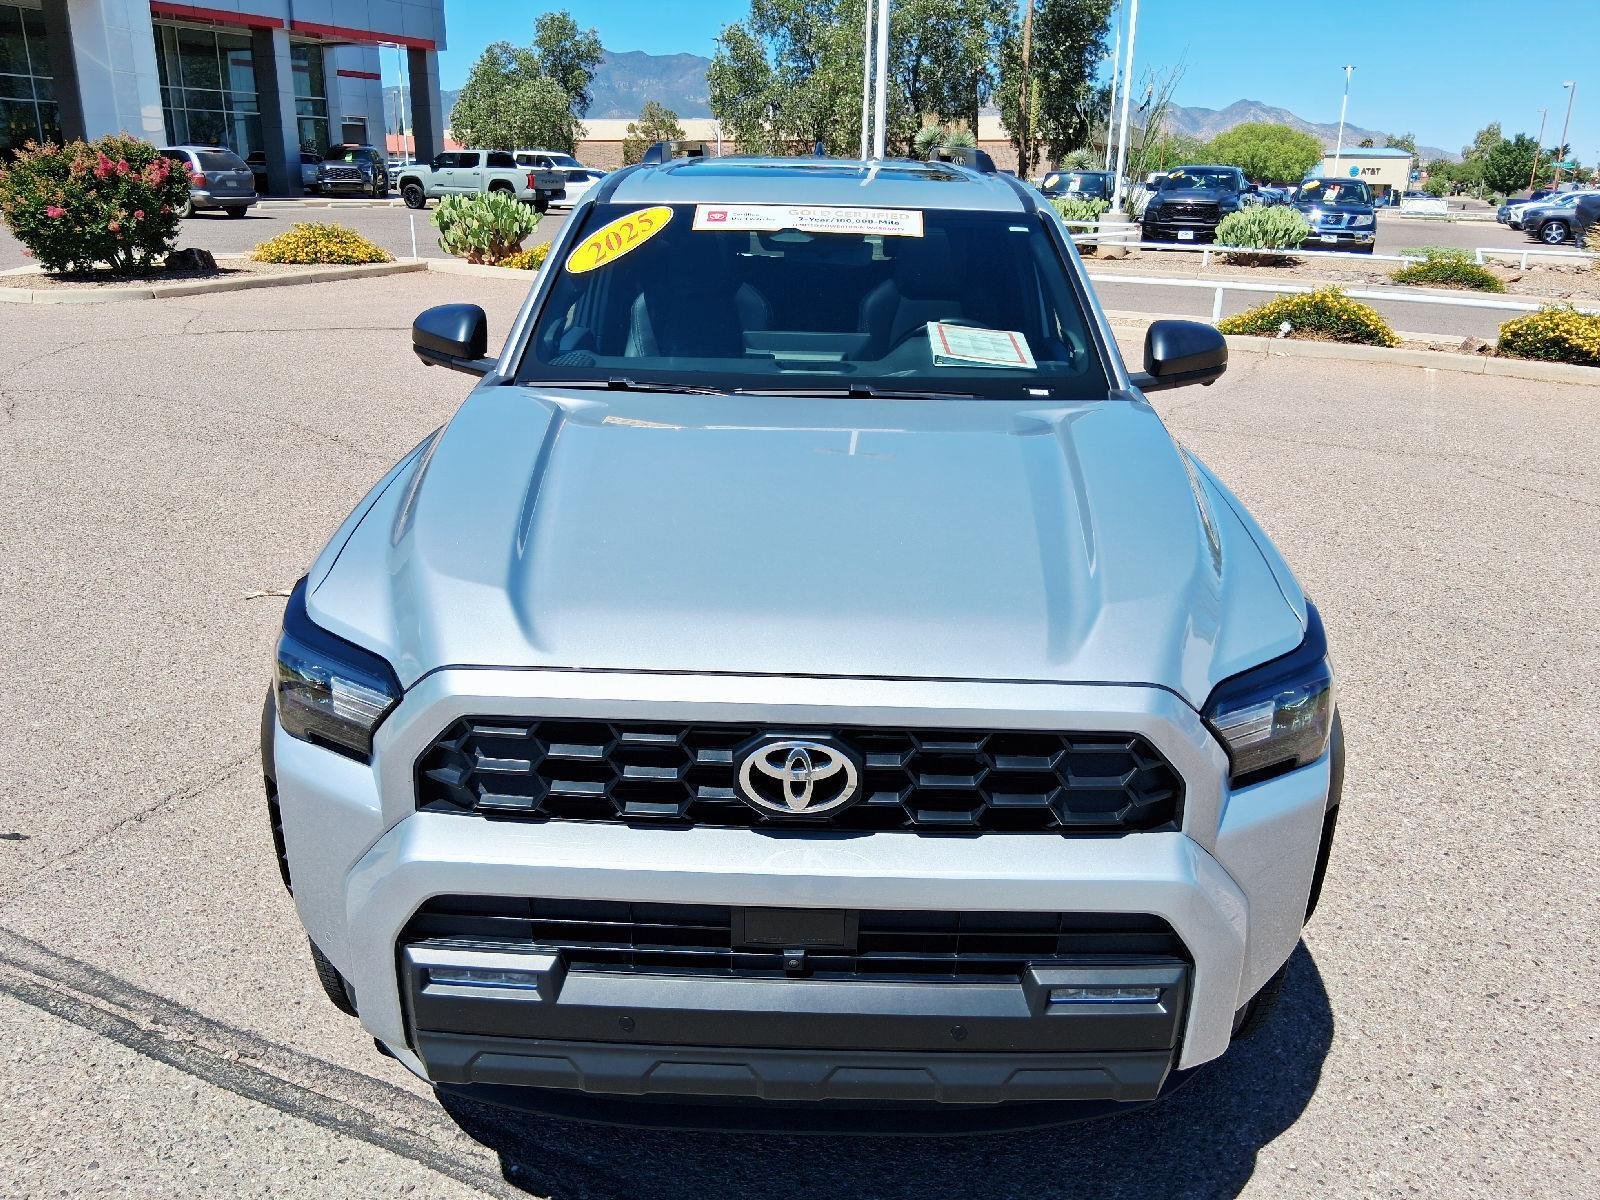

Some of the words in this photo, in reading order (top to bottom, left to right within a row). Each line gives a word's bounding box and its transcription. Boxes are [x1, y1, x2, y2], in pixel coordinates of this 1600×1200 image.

[1360, 167, 1381, 176] AT&T
[788, 208, 831, 217] GOLD
[834, 210, 910, 220] CERTIFIED
[588, 212, 654, 264] 2025
